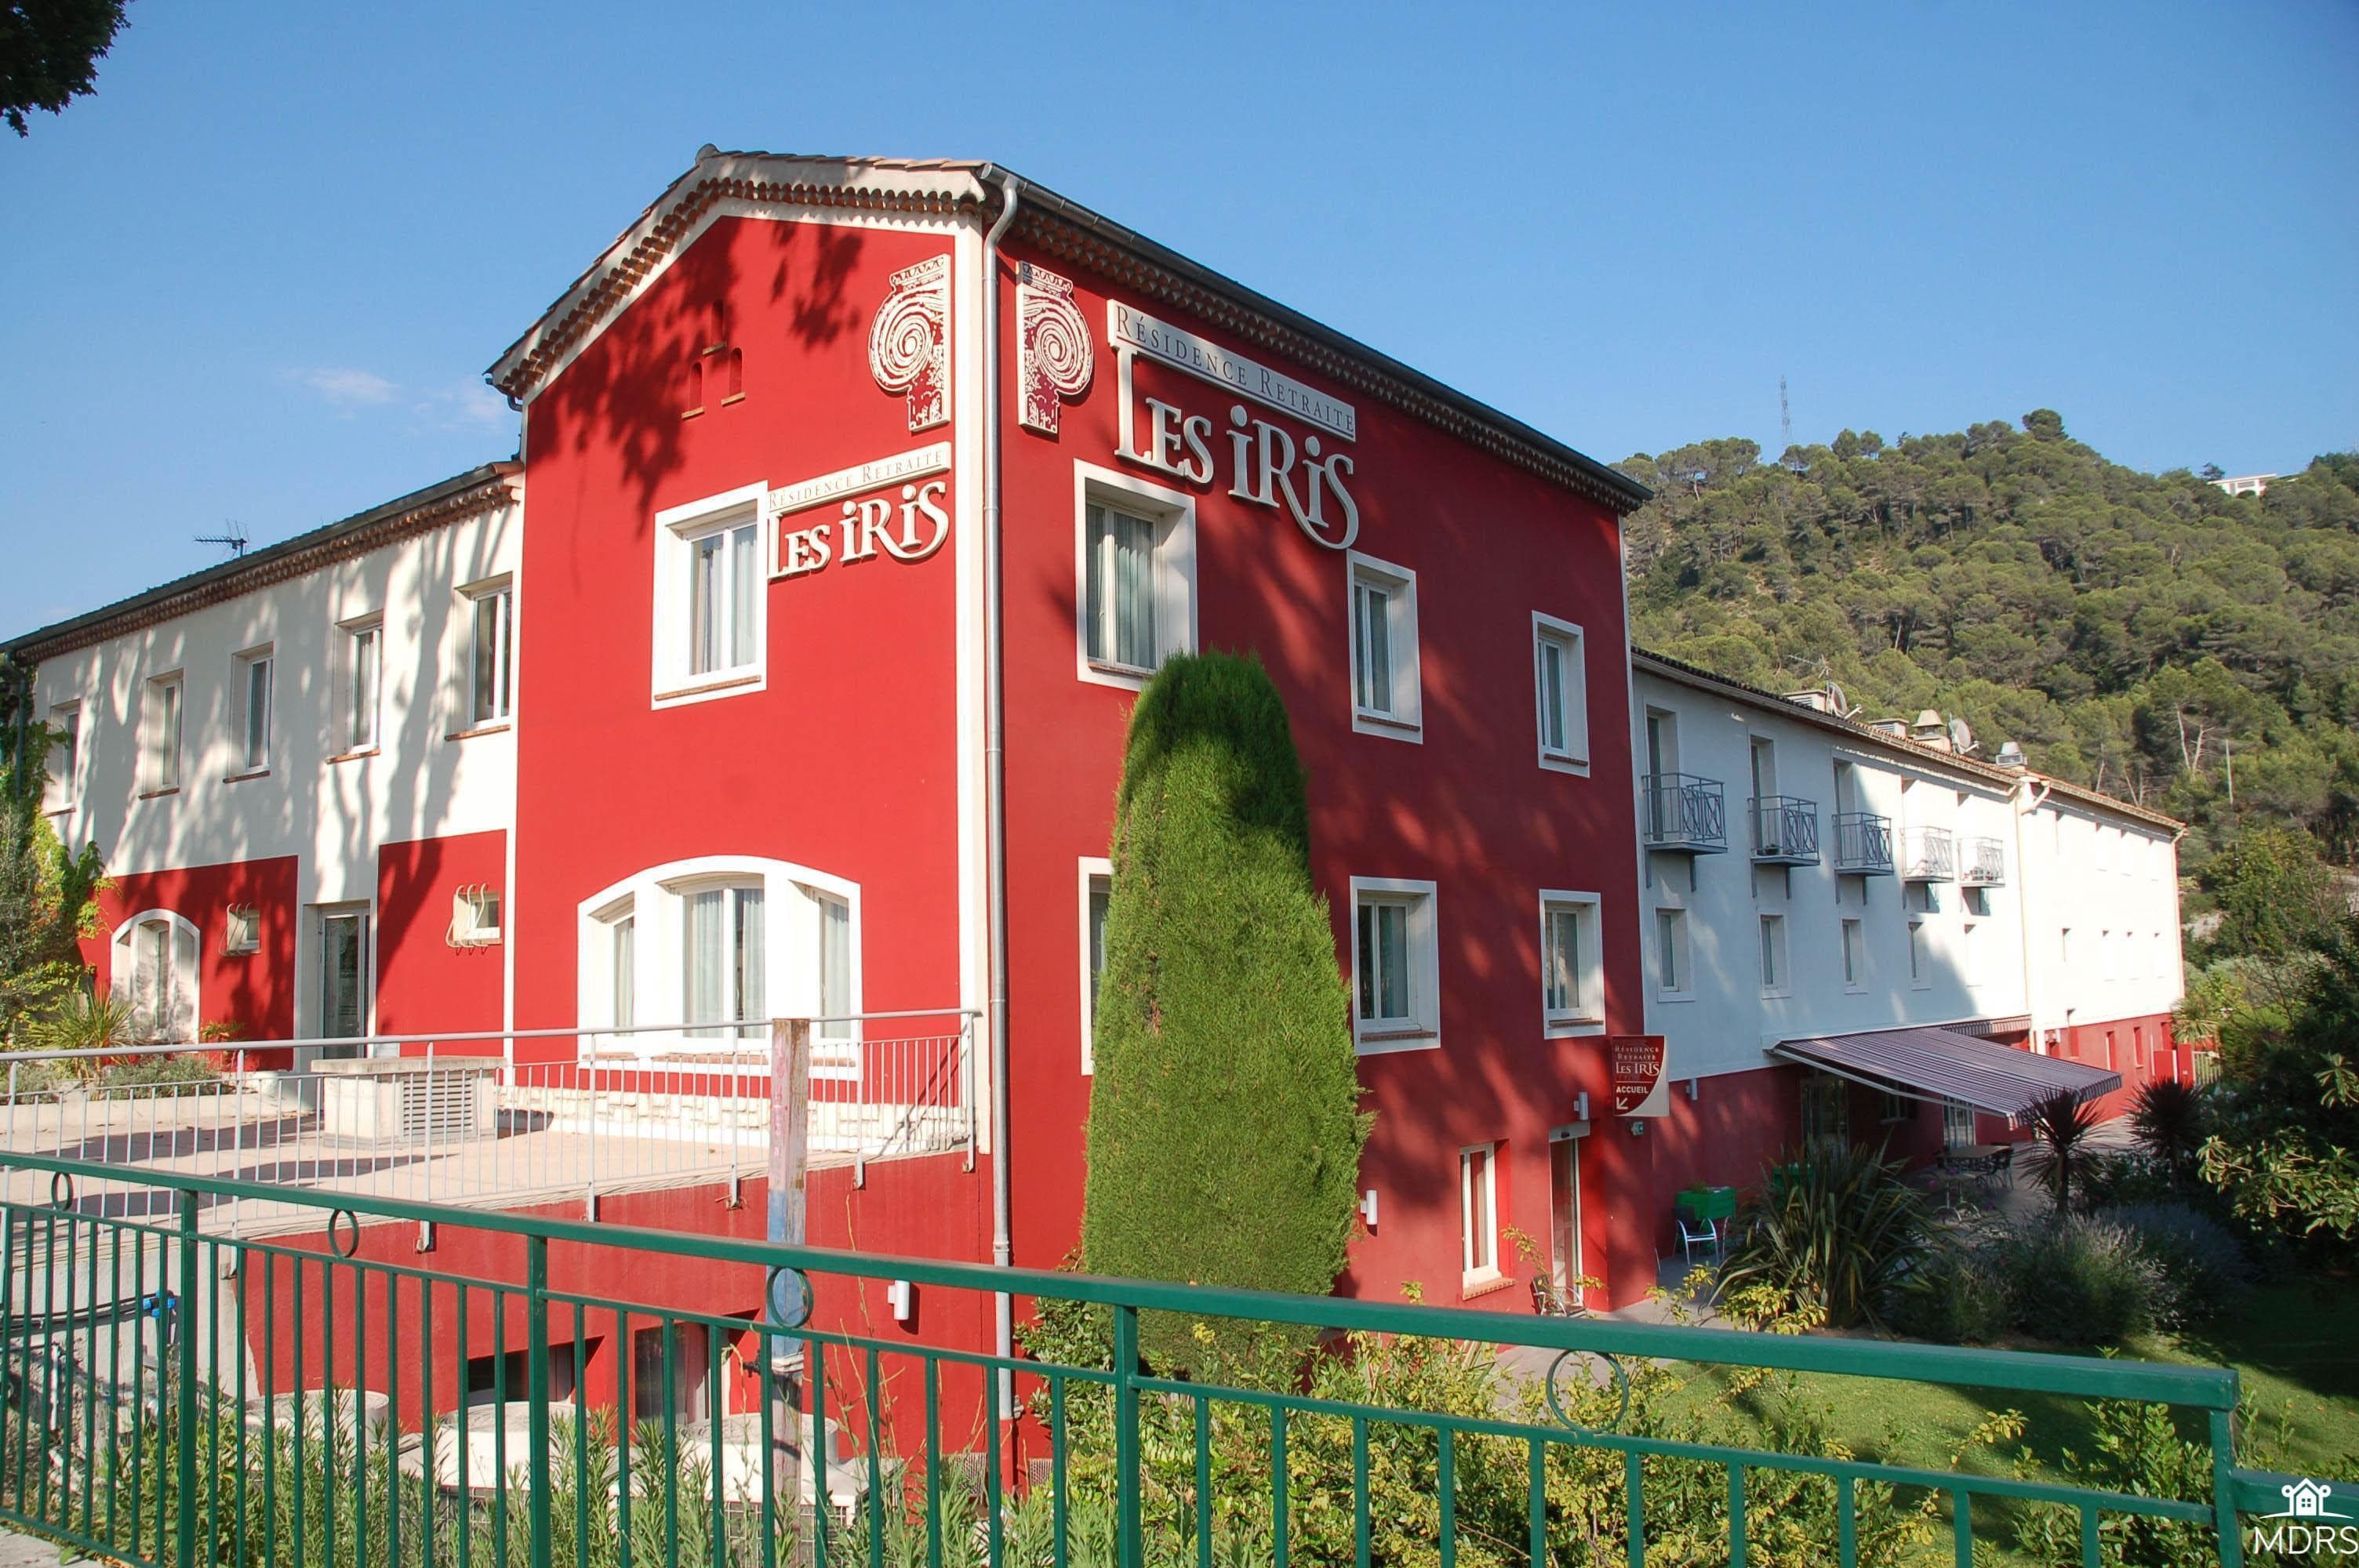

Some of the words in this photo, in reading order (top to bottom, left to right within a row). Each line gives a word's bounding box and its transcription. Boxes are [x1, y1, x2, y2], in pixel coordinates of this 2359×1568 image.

[1117, 306, 1248, 386] RÉSIDENCE
[1260, 369, 1354, 433] RETRAITE
[1114, 347, 1215, 485] LES
[768, 476, 854, 510] RÉSIDENCE
[862, 451, 943, 483] RETRAITE
[768, 511, 832, 579] LES
[1616, 1062, 1631, 1074] LES
